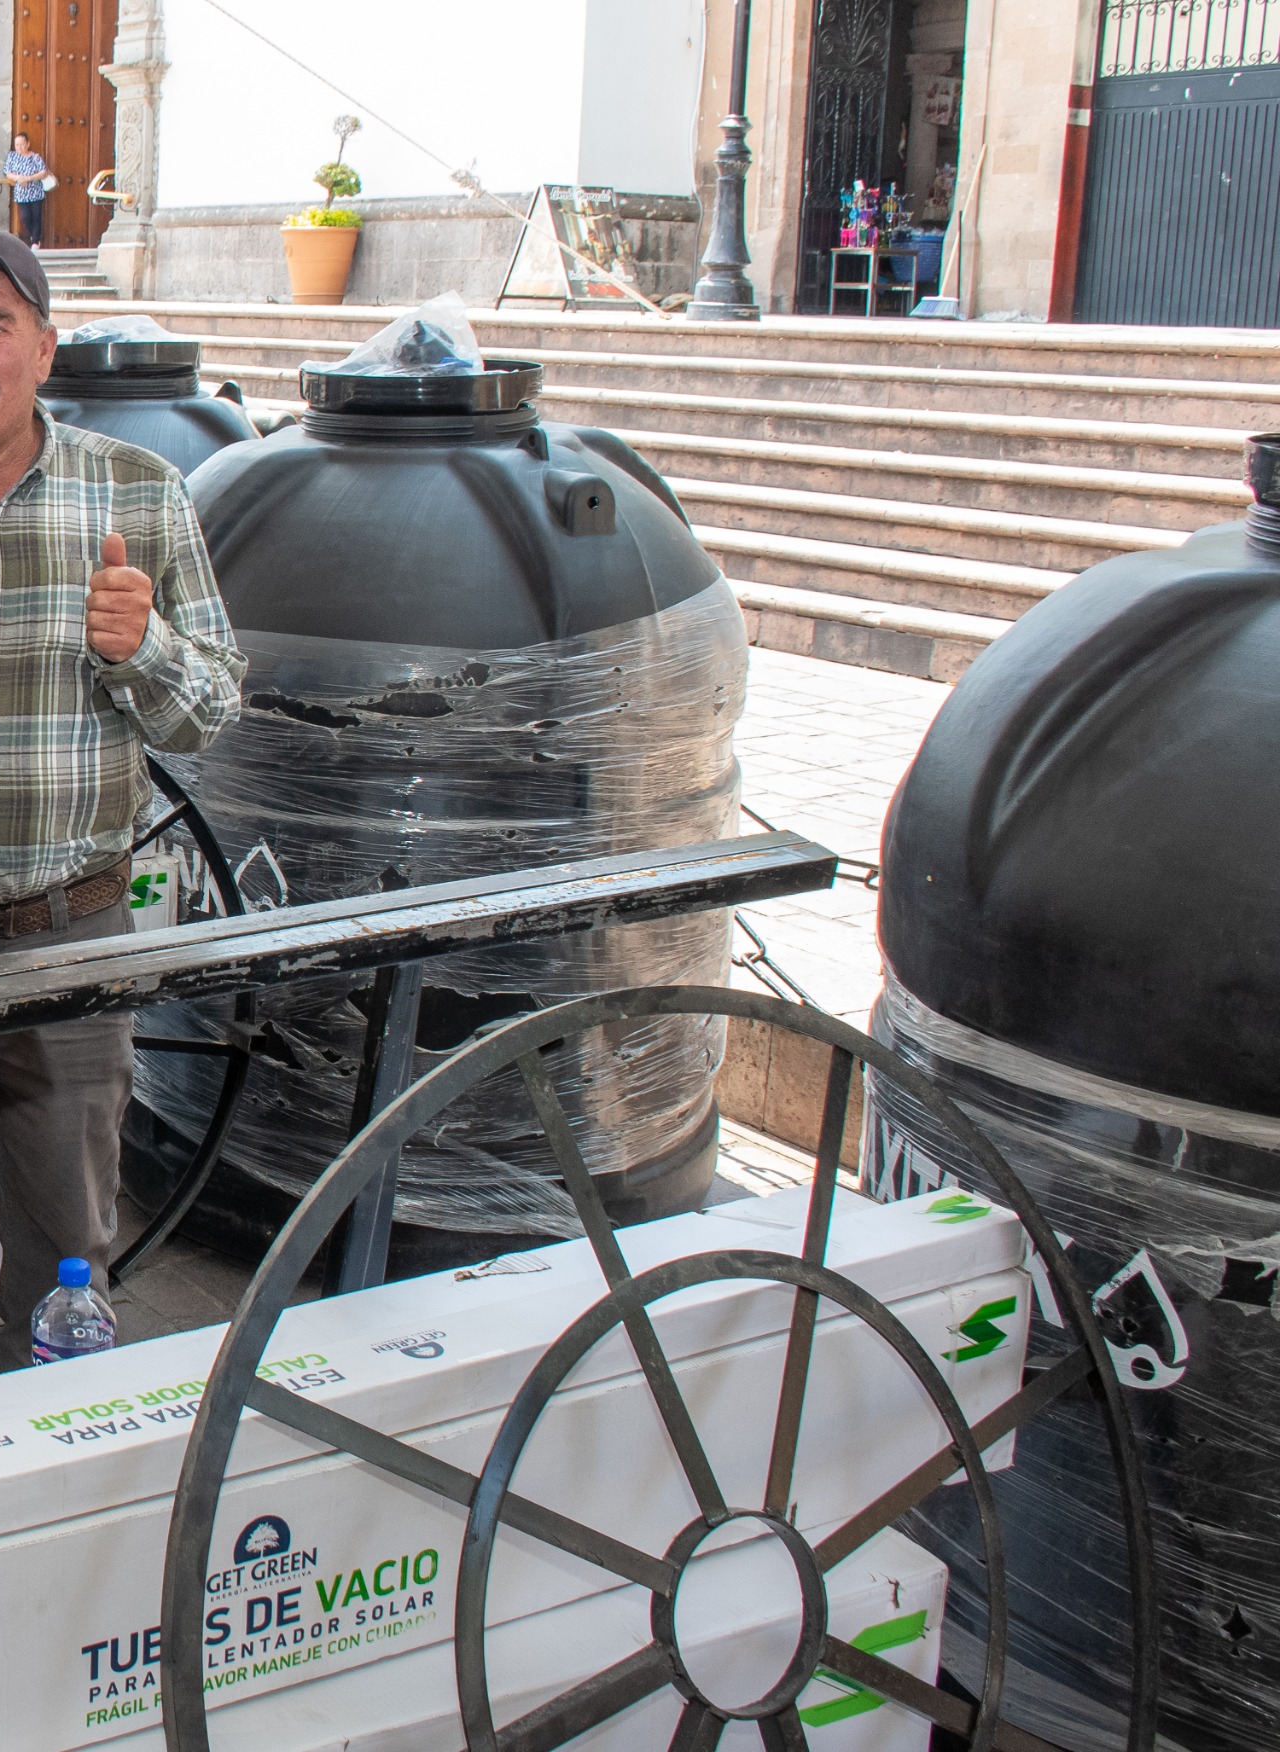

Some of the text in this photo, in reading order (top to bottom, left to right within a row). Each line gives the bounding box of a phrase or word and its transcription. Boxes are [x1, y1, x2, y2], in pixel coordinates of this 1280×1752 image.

[28, 1397, 127, 1432] SOLAR
[50, 1415, 136, 1445] PARA
[205, 1546, 318, 1595] GET GREEN
[253, 1569, 313, 1592] ALTERNATIVA
[81, 1548, 439, 1681] TUBS DE VACIO
[85, 1694, 150, 1728] FRÁGIL
[203, 1665, 248, 1693] AVOR
[253, 1644, 323, 1678] MANEJE
[328, 1633, 361, 1655] CON
[365, 1611, 438, 1643] CUIDADO
[89, 1670, 156, 1703] PARA
[207, 1617, 340, 1669] LENTADOR
[355, 1590, 435, 1626] SOLAR
